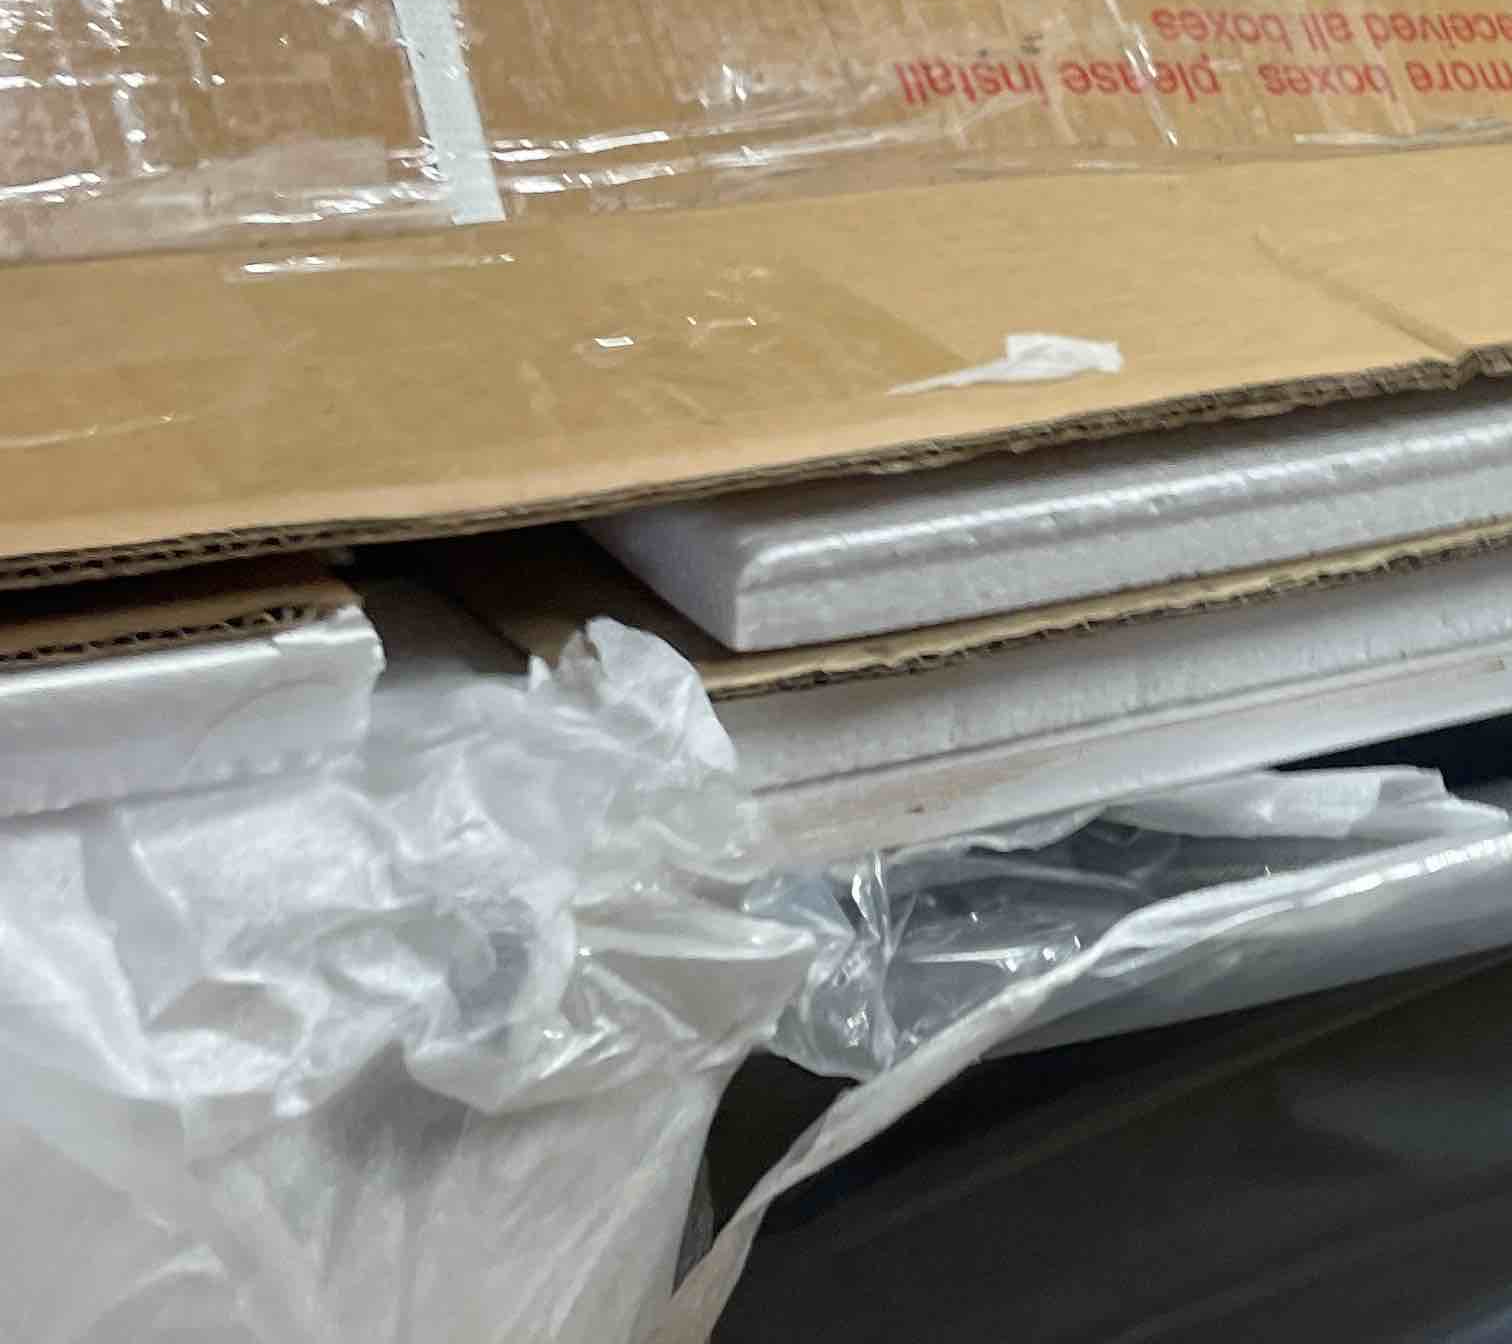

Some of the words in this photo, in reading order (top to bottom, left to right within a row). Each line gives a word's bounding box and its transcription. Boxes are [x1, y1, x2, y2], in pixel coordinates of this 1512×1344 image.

[1151, 7, 1293, 53] boxes
[1300, 10, 1353, 53] all
[895, 61, 1045, 108] install
[1059, 52, 1220, 105] please
[1260, 61, 1394, 103] boxes
